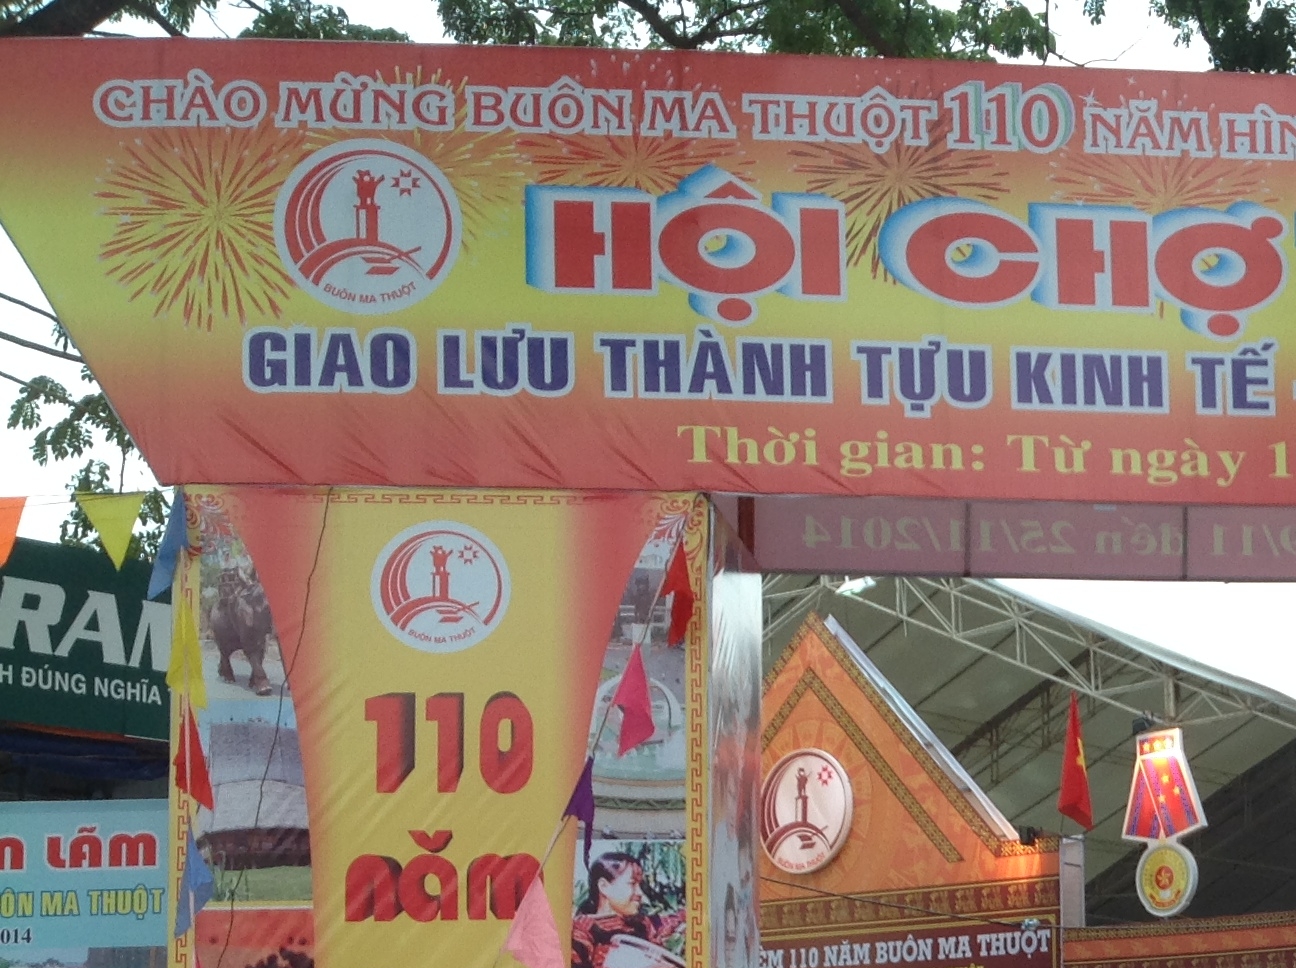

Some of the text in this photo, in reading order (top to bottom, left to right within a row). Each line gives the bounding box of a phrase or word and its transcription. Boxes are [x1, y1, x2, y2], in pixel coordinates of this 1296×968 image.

[96, 72, 264, 126] CHÀO
[279, 75, 450, 128] MỪNG
[470, 77, 629, 132] BUÔN
[648, 94, 735, 136] MA
[747, 90, 936, 150] THUỘT
[949, 83, 1072, 152] 110
[1090, 101, 1209, 156] NĂM
[545, 178, 848, 326] HỘI
[898, 213, 1290, 340] CHỢ
[323, 281, 418, 305] BUÔN MA THUỘT
[248, 330, 414, 392] GIAO
[443, 327, 571, 395] LƯU
[600, 332, 830, 400] THÀNH
[856, 340, 991, 418] TỰU
[1013, 350, 1168, 410] KINH
[1189, 344, 1277, 414] TẾ
[676, 424, 816, 468] Thời
[839, 435, 986, 477] gian:
[1007, 433, 1091, 474] Từ
[1110, 438, 1247, 487] ngày
[21, 664, 88, 696] ĐÚNG
[94, 676, 163, 706] NGHĨA
[364, 690, 535, 795] 110
[46, 825, 158, 869] LÃM
[41, 889, 80, 917] MA
[88, 883, 165, 920] THUỘT
[824, 939, 872, 968] NĂM
[875, 934, 934, 964] BUÔN
[938, 934, 972, 961] MA
[977, 929, 1051, 959] THUỘT
